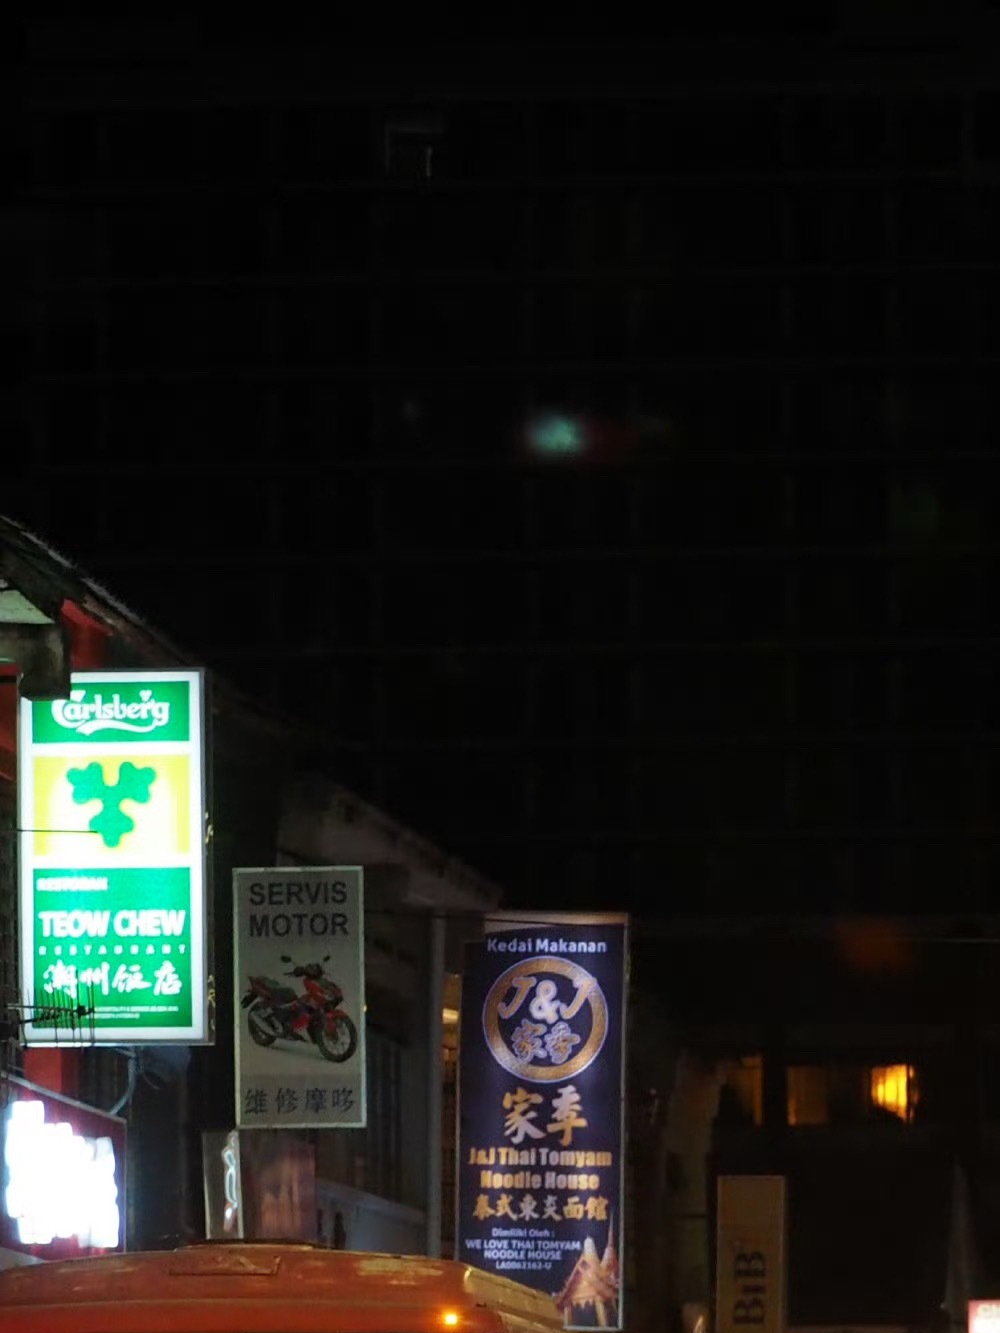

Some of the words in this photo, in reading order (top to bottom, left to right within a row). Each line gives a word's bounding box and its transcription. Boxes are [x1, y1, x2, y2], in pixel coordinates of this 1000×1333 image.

[51, 690, 170, 733] Carlsberg
[249, 881, 347, 906] SERVIS
[38, 910, 110, 937] TEOW
[113, 910, 186, 937] CHEW
[249, 913, 349, 937] MOTOR
[487, 938, 532, 953] Kedai
[535, 938, 607, 953] Makanan
[502, 1084, 588, 1146] 家季
[498, 1147, 536, 1165] Thai
[539, 1148, 612, 1168] Tomyam
[480, 1170, 542, 1189] Noodle
[544, 1171, 600, 1190] House
[466, 1239, 482, 1249] WE
[483, 1239, 509, 1249] LOVE
[511, 1240, 535, 1249] THAI
[537, 1240, 581, 1250] TOMYAM
[484, 1249, 525, 1259] NOODLE
[527, 1250, 562, 1260] HOUSE
